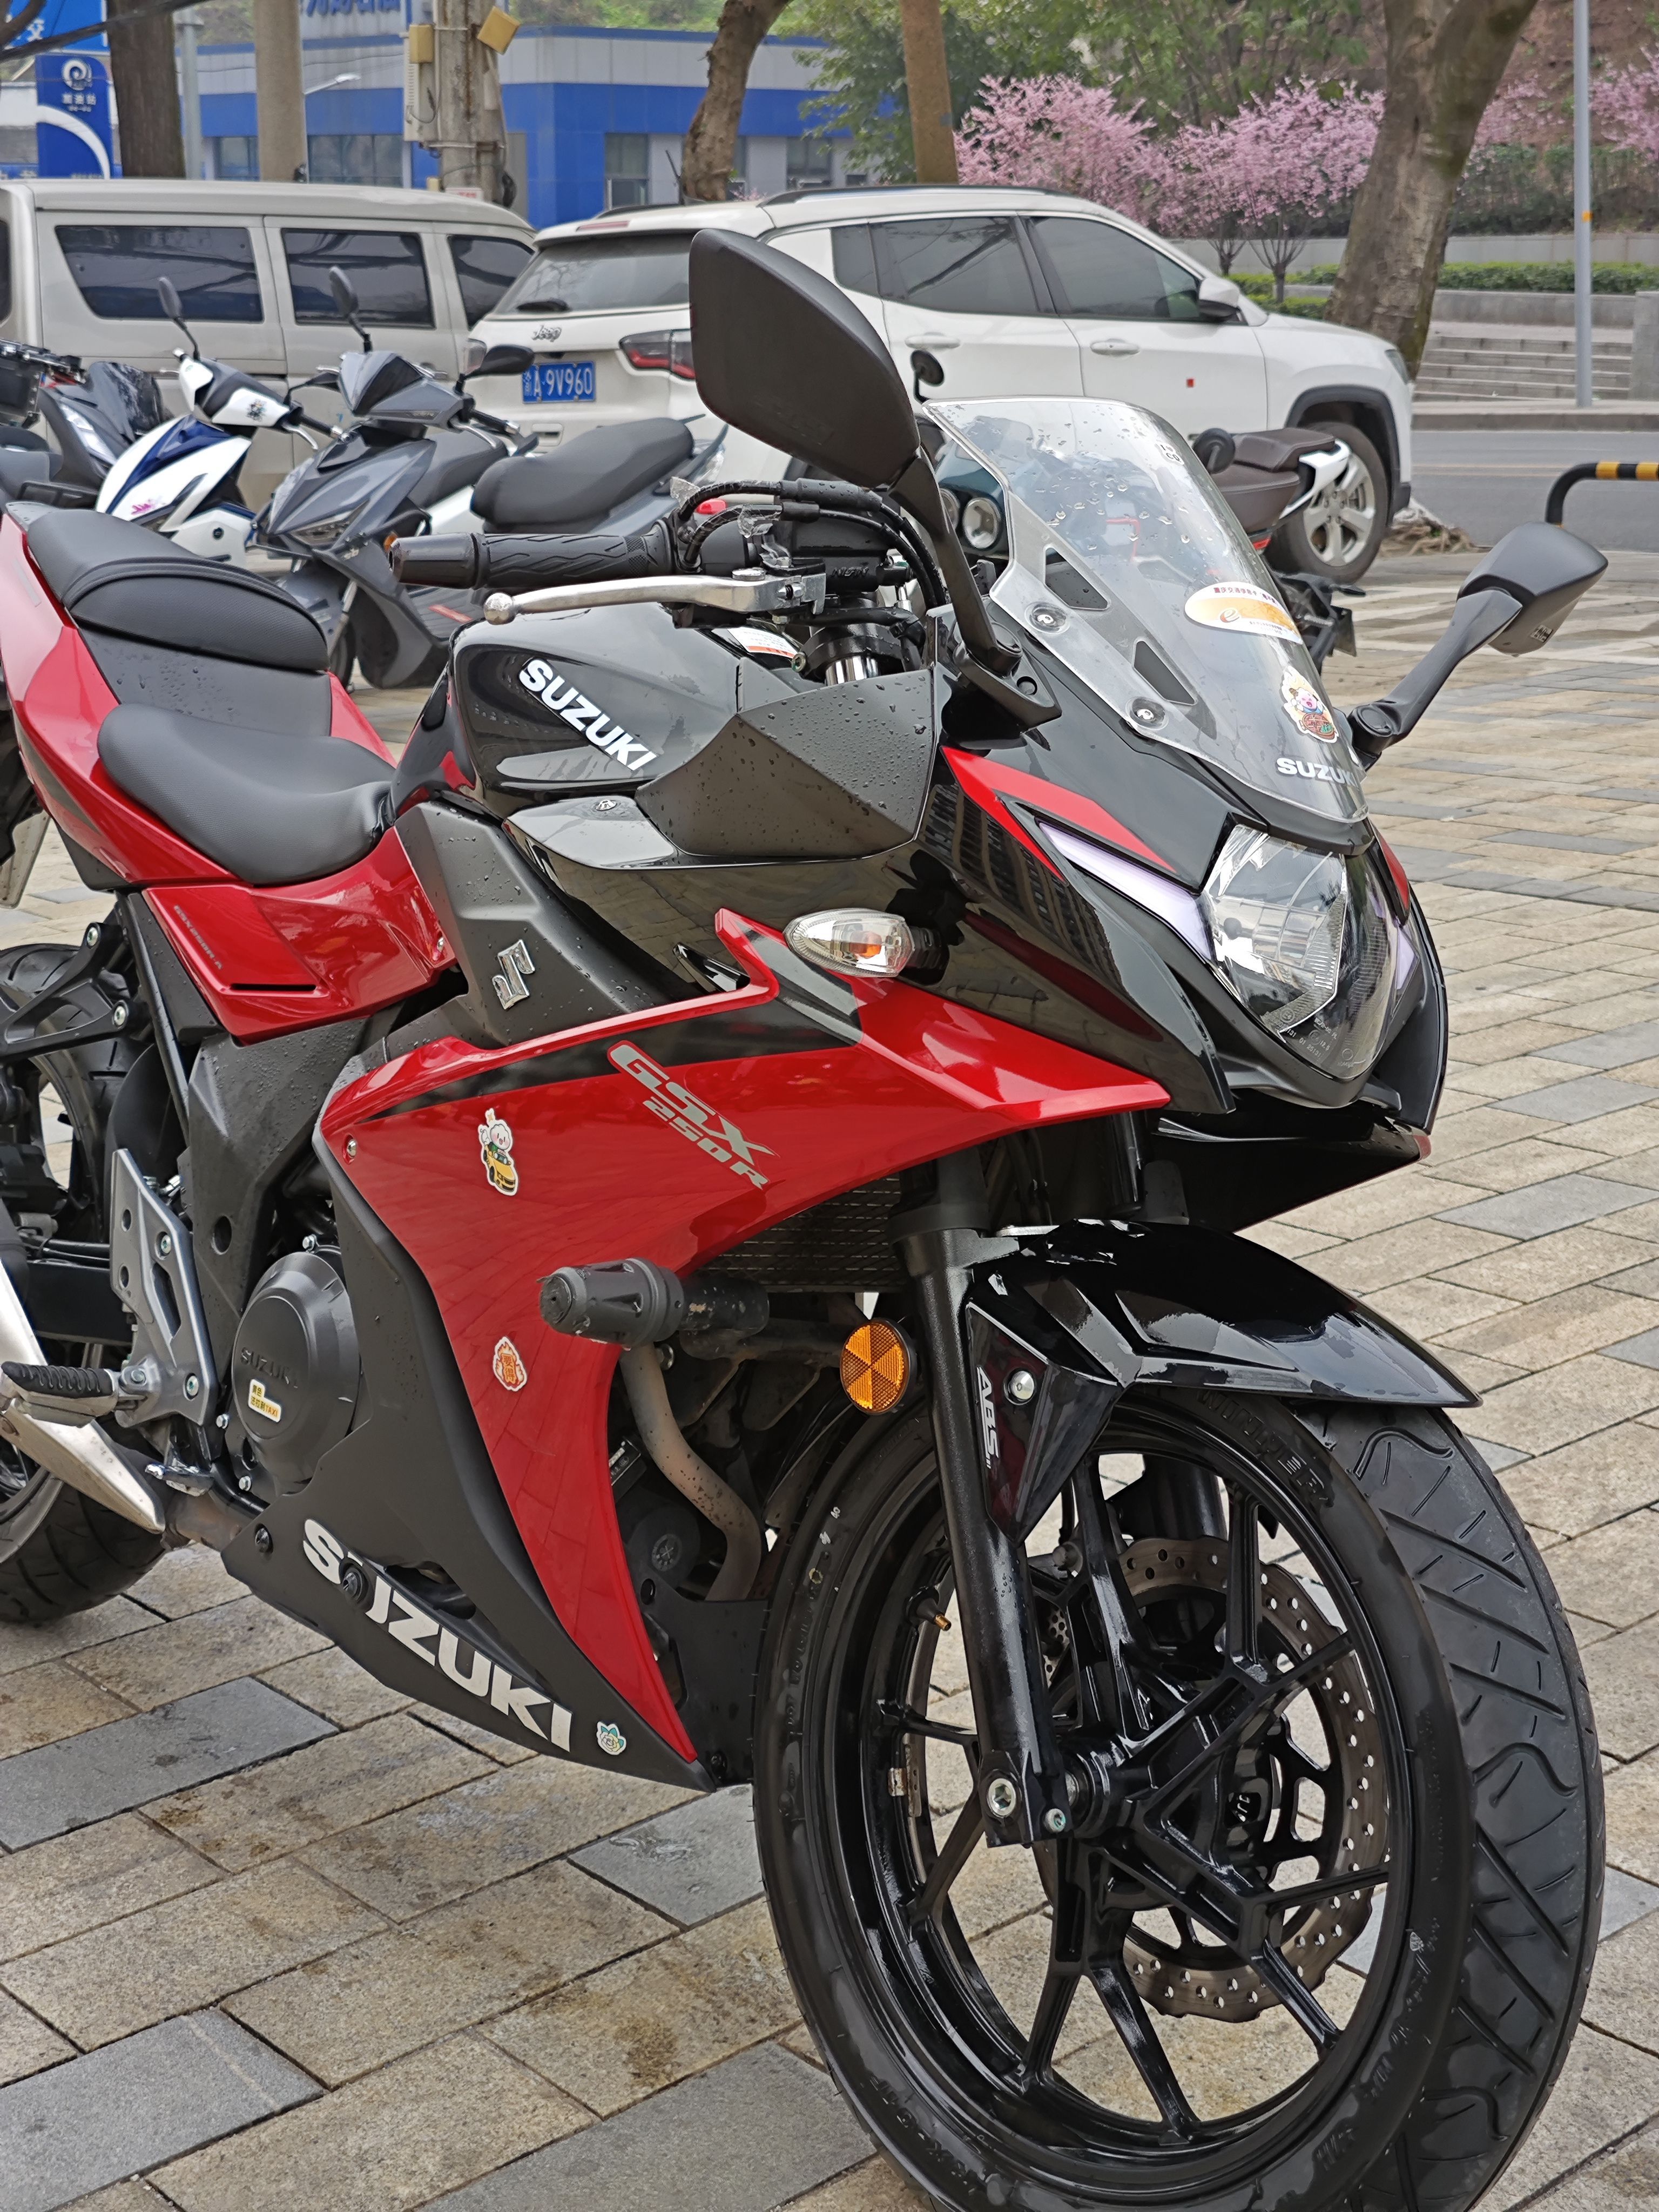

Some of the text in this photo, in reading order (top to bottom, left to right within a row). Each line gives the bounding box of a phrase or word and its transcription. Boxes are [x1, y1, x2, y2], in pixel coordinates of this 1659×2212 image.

[531, 325, 562, 342] Jeep
[519, 658, 657, 771] SUZUKI
[609, 1044, 776, 1166] GSX
[241, 1346, 298, 1389] SUZUKI
[978, 1366, 1000, 1459] ABS
